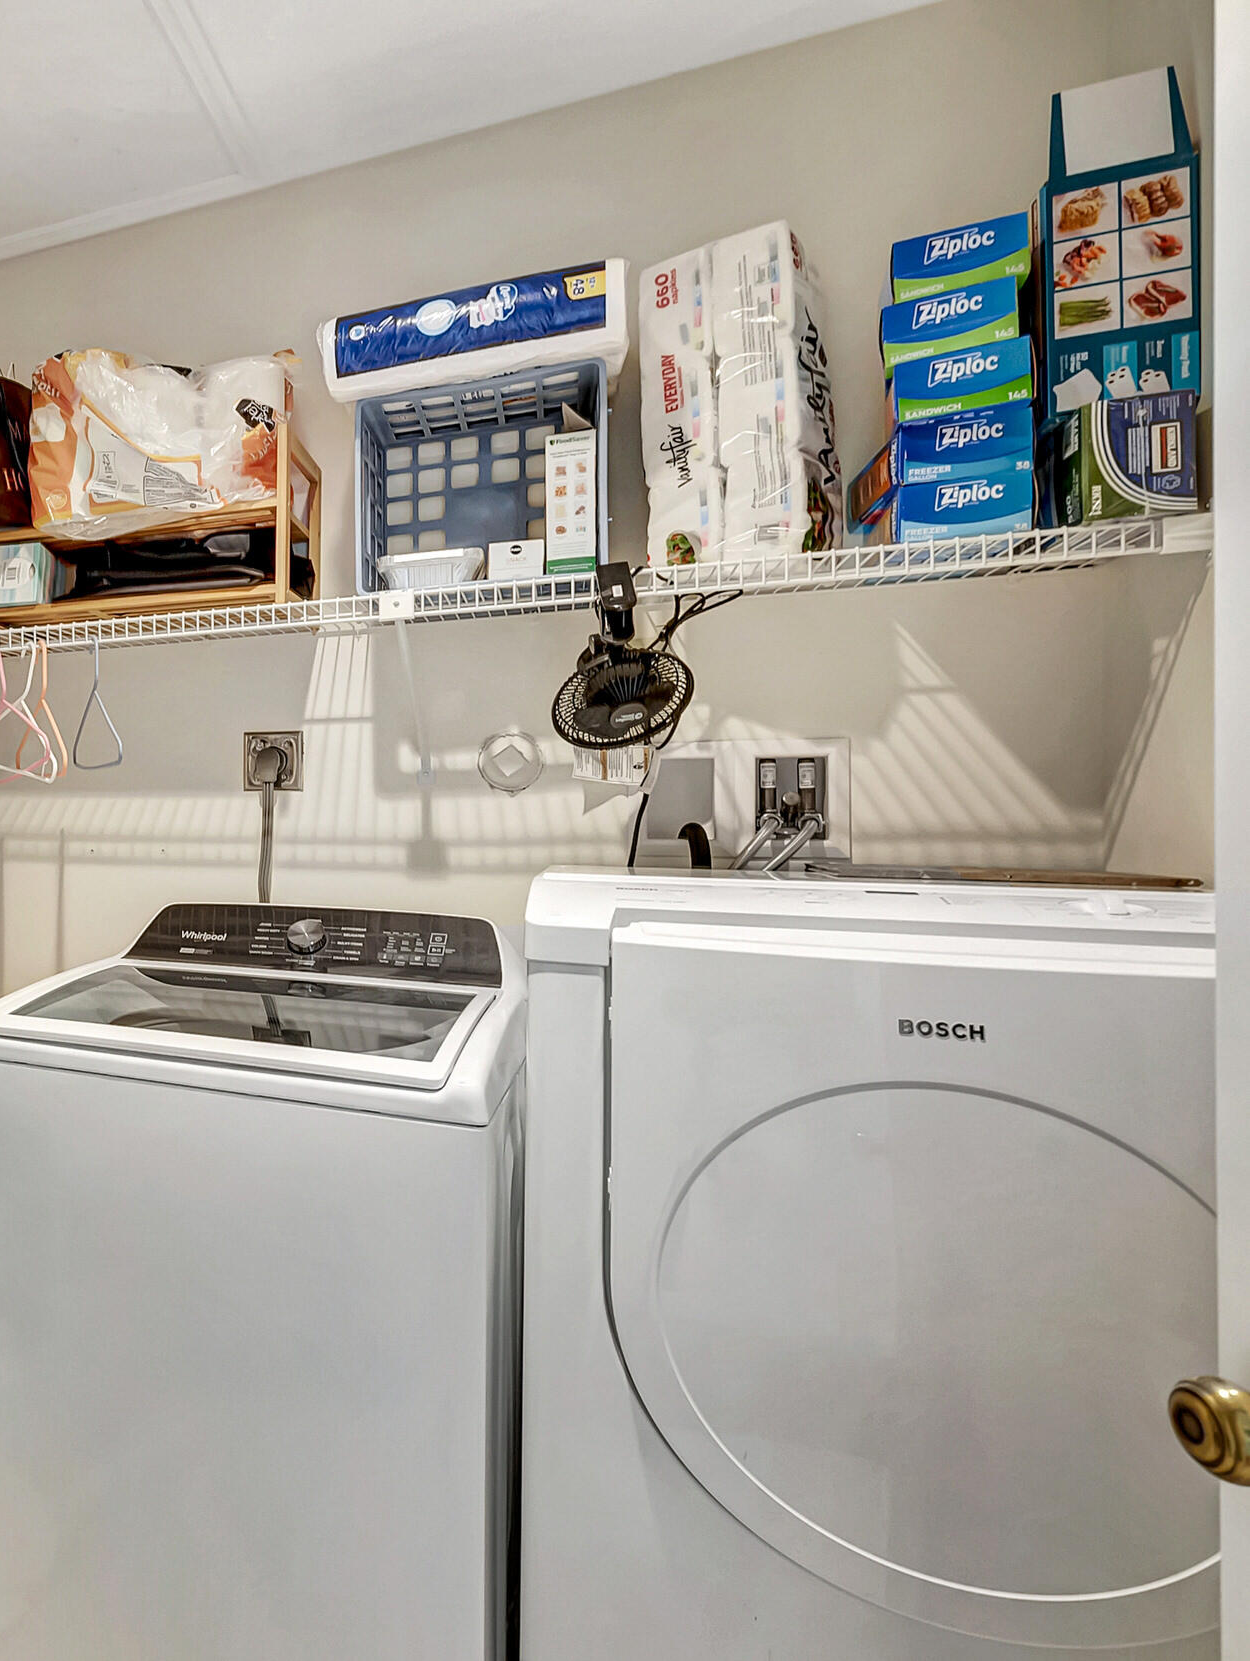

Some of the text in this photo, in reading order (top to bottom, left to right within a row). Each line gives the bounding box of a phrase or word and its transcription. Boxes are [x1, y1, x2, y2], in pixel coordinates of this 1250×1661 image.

[930, 229, 996, 260] Ziploc
[654, 273, 670, 309] 660
[918, 294, 984, 325] Ziploc
[933, 355, 999, 383] Ziploc
[661, 354, 679, 414] EVERYDAY
[905, 402, 962, 420] SANDWICH
[941, 422, 1004, 448] Ziploc
[908, 464, 951, 477] FREEZER
[941, 484, 1004, 508] Ziploc
[181, 930, 228, 942] Whirlpool
[898, 1018, 986, 1042] BOSCH
